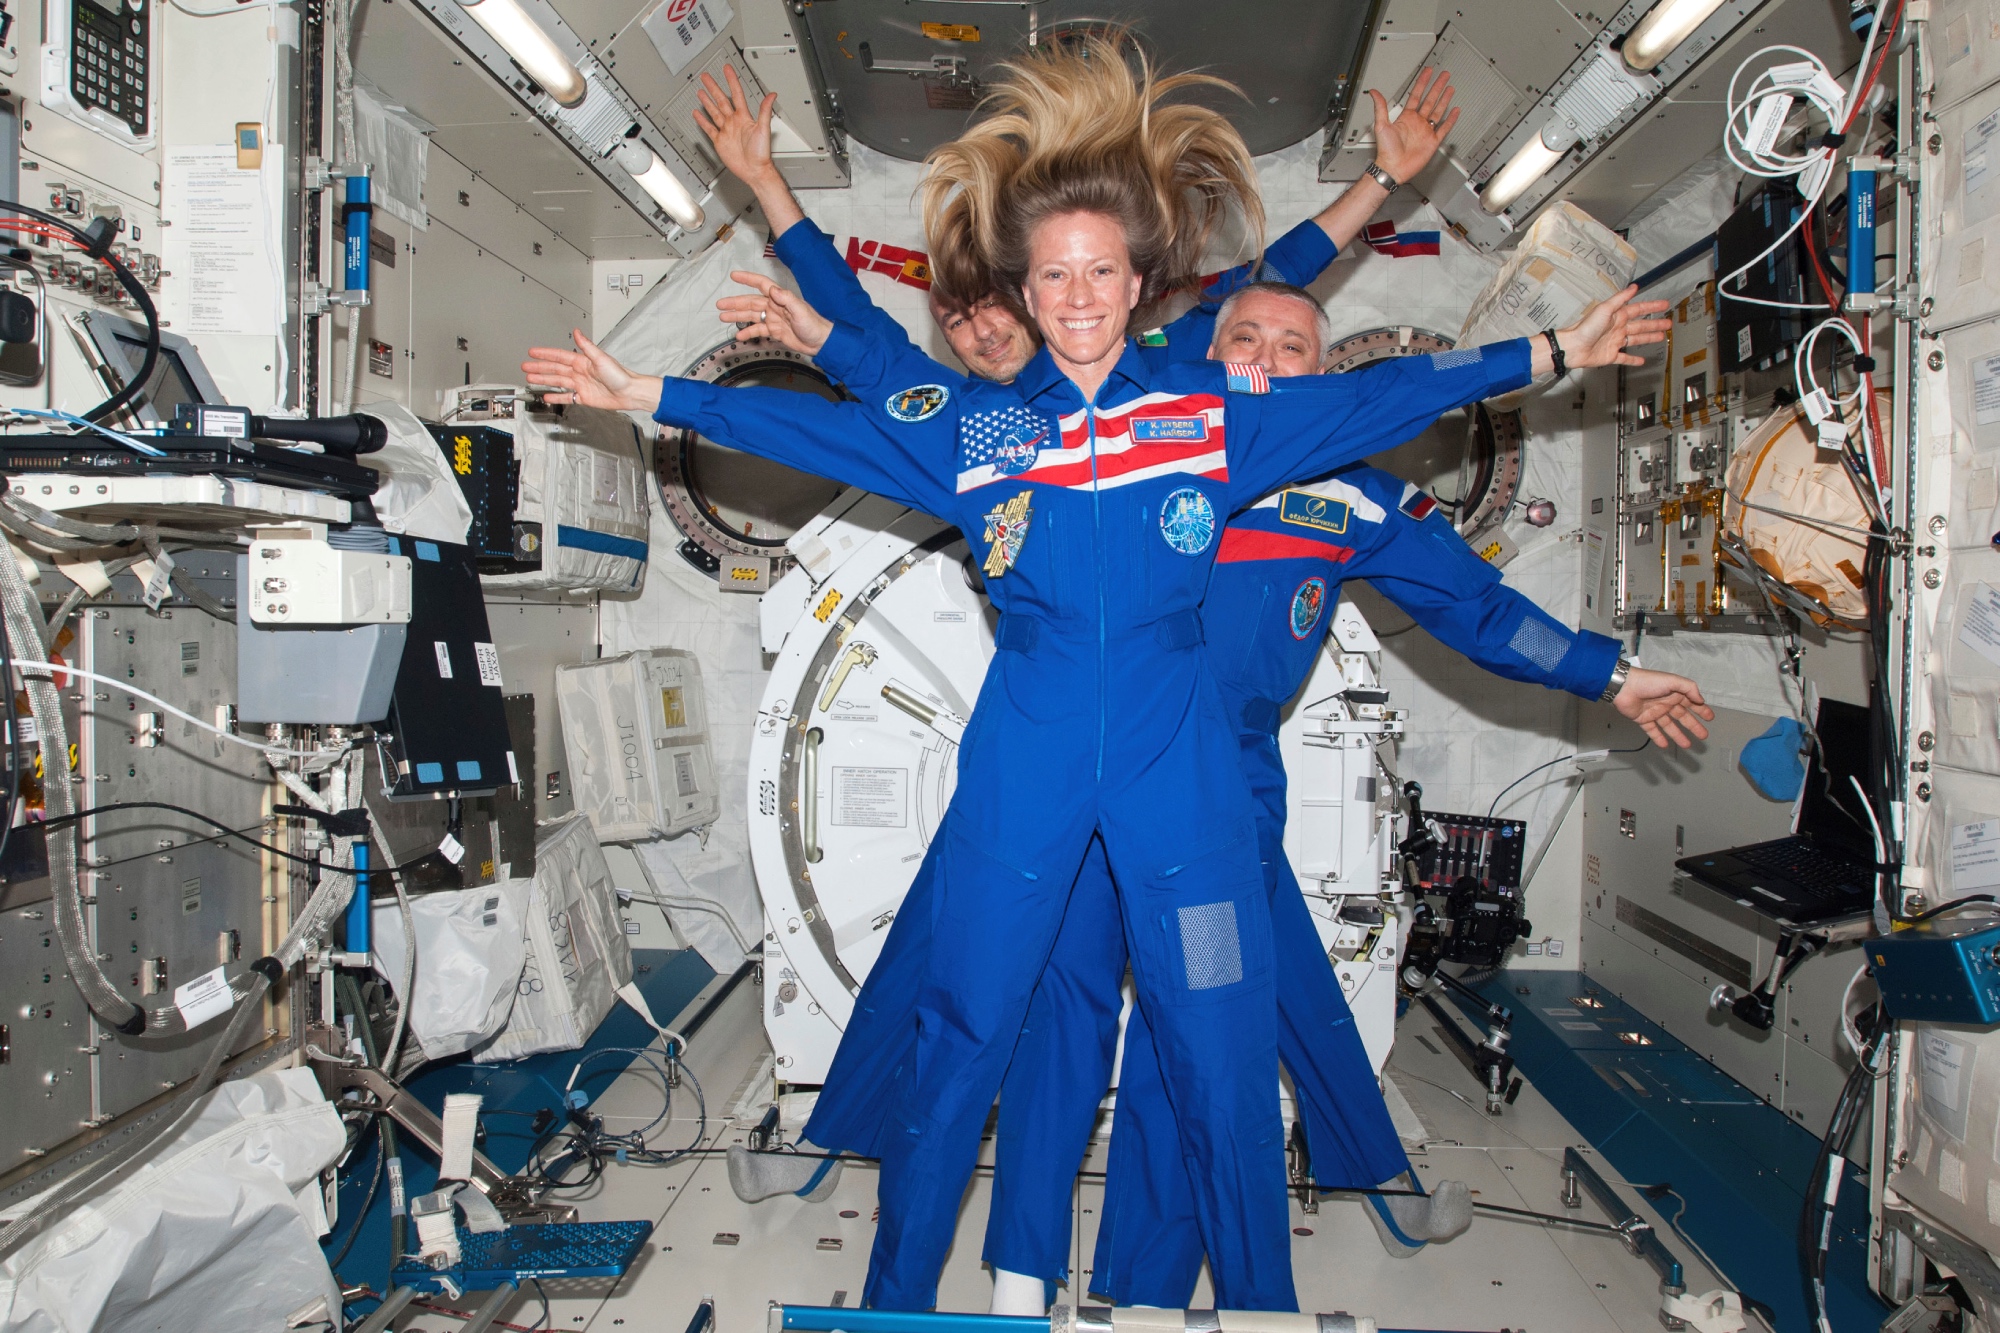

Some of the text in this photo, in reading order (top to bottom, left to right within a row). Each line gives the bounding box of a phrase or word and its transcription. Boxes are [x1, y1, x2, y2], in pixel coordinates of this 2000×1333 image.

[687, 11, 701, 30] GOLD
[676, 23, 693, 46] AWARD
[996, 445, 1036, 458] NASA
[1288, 513, 1339, 528] ФЁДОР ЮРЧИХИН
[478, 648, 488, 680] MSPR
[484, 648, 494, 680] Laptop
[491, 651, 500, 678] JAXA
[616, 715, 643, 783] J1004
